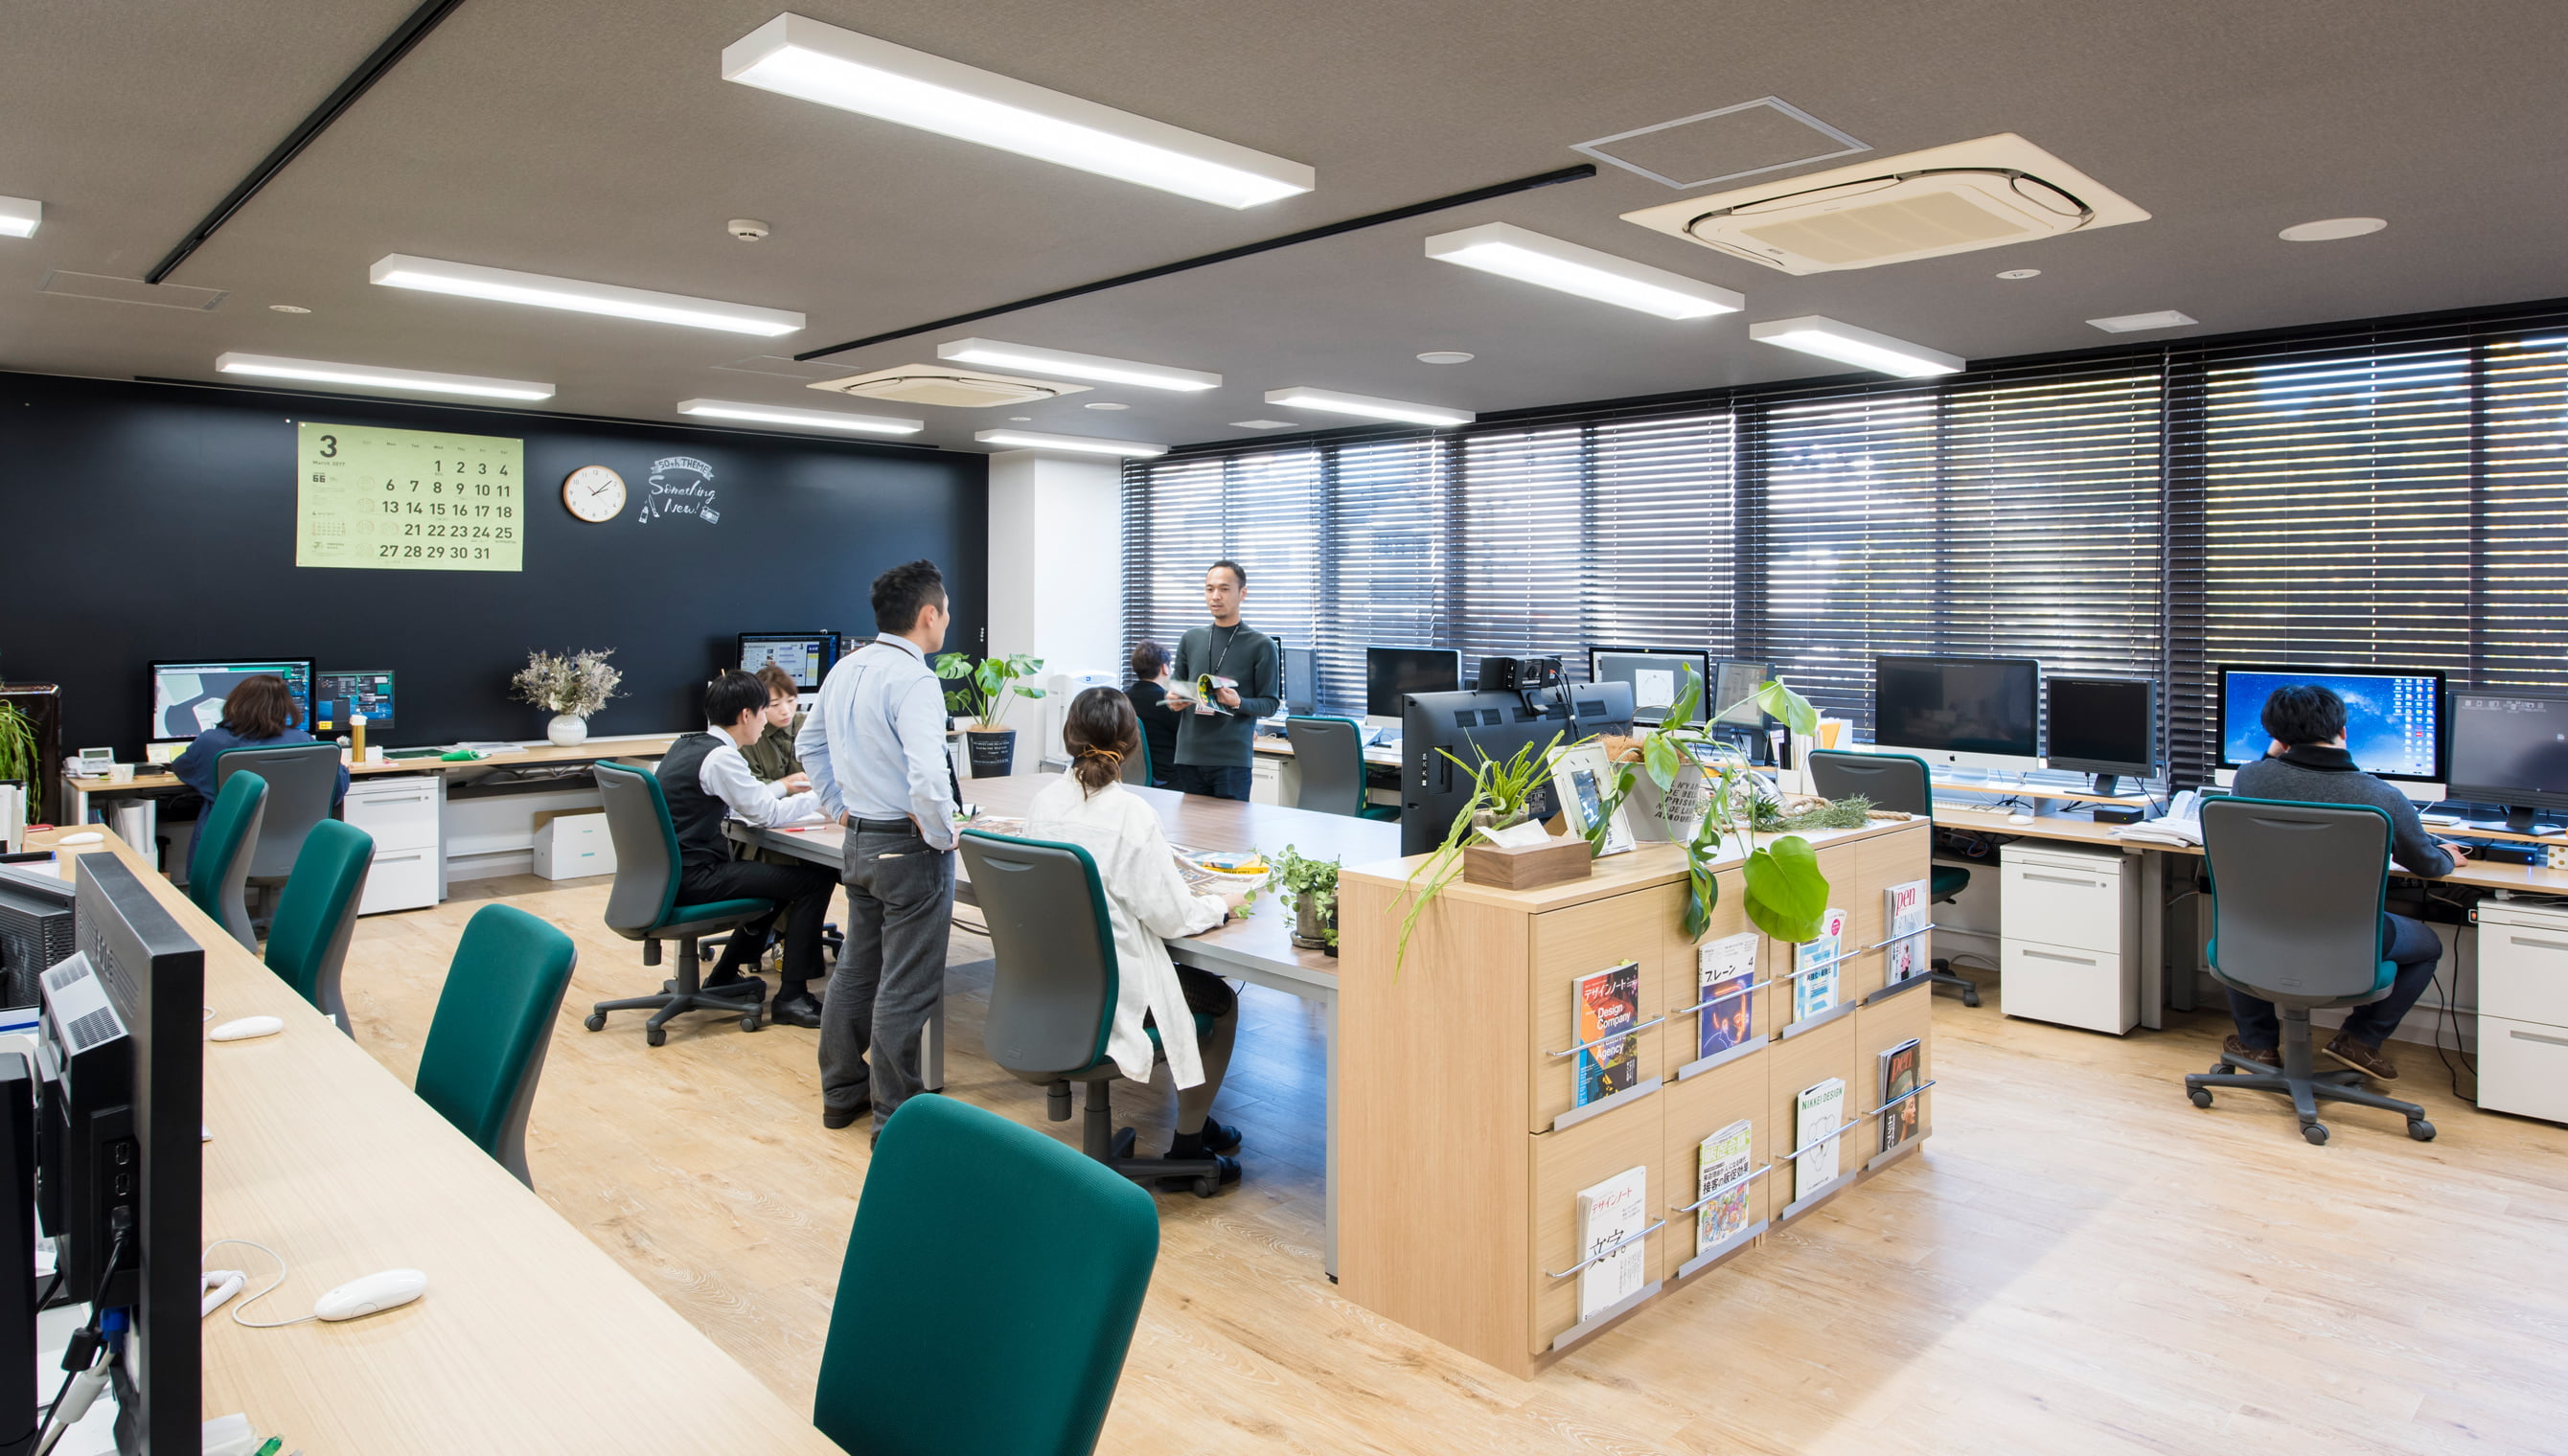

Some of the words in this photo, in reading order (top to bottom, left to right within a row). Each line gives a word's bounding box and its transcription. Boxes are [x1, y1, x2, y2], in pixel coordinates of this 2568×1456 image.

[319, 434, 337, 458] 3
[434, 460, 442, 472] 1
[456, 461, 466, 474] 2
[478, 463, 487, 475] 3
[499, 465, 509, 477] 4
[658, 458, 680, 469] 50th
[680, 458, 710, 475] THEME
[386, 478, 396, 491] 6
[409, 480, 420, 492] 7
[433, 481, 443, 493] 8
[455, 483, 465, 495] 9
[474, 484, 491, 496] 10
[496, 485, 511, 498] 11
[648, 474, 716, 505] Something
[382, 500, 400, 513] 13
[405, 502, 424, 514] 14
[429, 503, 446, 515] 15
[452, 504, 469, 517] 16
[474, 505, 491, 518] 17
[495, 506, 513, 518] 18
[664, 498, 700, 514] New!
[403, 523, 421, 536] 21
[426, 524, 446, 537] 22
[449, 525, 469, 538] 23
[471, 526, 491, 538] 24
[494, 527, 513, 539] 25
[378, 544, 400, 557] 27
[403, 545, 423, 558] 28
[426, 546, 446, 558] 29
[449, 547, 469, 559] 30
[473, 547, 490, 559] 31
[1895, 886, 1915, 917] pen
[1748, 956, 1754, 967] 4
[1584, 977, 1627, 1001] デザインノート
[1597, 1004, 1623, 1019] Design
[1596, 1012, 1631, 1031] Company
[1595, 1043, 1624, 1060] Agency
[1891, 1050, 1914, 1083] pen
[1801, 1096, 1823, 1111] NIKKEI
[1823, 1087, 1844, 1103] DESIGN
[1592, 1187, 1633, 1216] デザインノート
